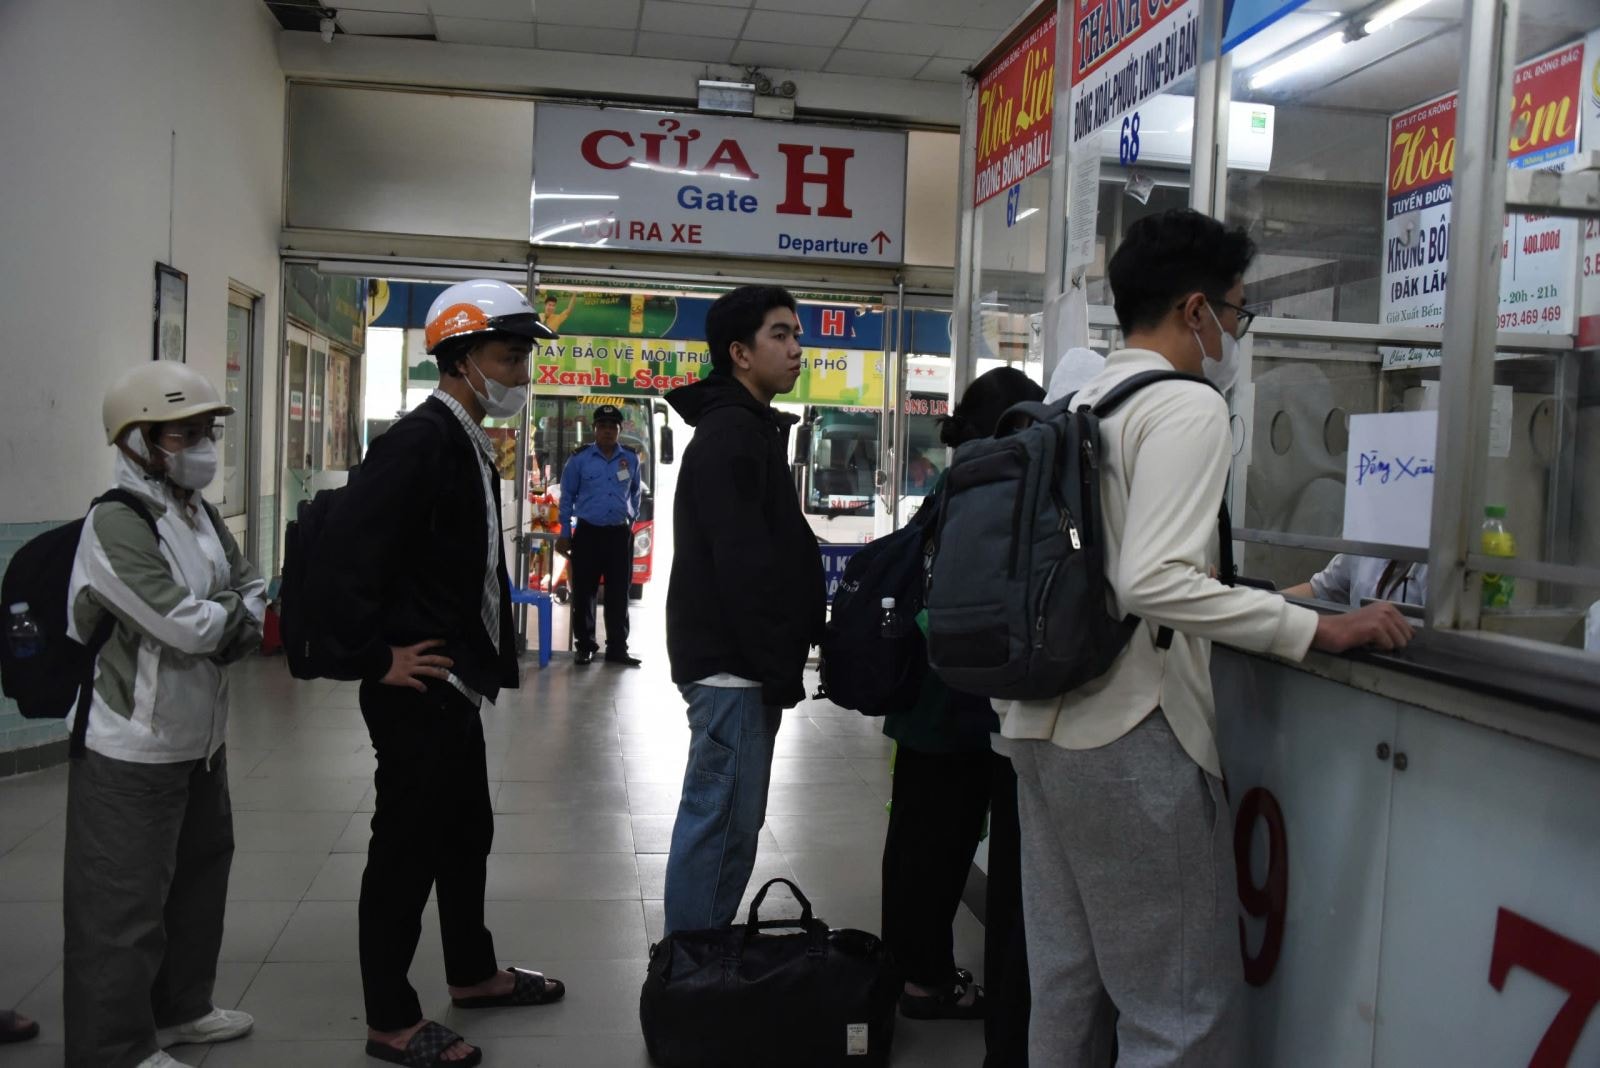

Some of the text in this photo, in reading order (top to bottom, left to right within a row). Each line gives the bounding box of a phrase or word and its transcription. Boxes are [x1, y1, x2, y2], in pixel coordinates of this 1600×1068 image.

[977, 82, 1014, 162] Hòa
[1120, 111, 1140, 168] 68
[581, 118, 854, 218] CỬA H
[678, 185, 758, 214] Gate
[1007, 183, 1020, 227] 67
[1392, 190, 1423, 215] TUYẾN
[630, 221, 662, 242] RA
[670, 223, 702, 244] XE
[779, 234, 868, 254] Departure
[1523, 229, 1560, 255] 400.000đ
[1391, 276, 1420, 303] (ĐĂK
[1509, 290, 1528, 304] 20h
[1537, 284, 1557, 299] 21h
[821, 309, 845, 337] H
[1541, 305, 1561, 323] 469
[534, 345, 566, 357] TAY
[573, 342, 608, 359] BẢO
[615, 345, 634, 361] VỆ
[642, 348, 671, 362] MÔI
[814, 355, 848, 371] PHỐ
[538, 364, 610, 387] Xanh
[1488, 906, 1600, 1068] 7
